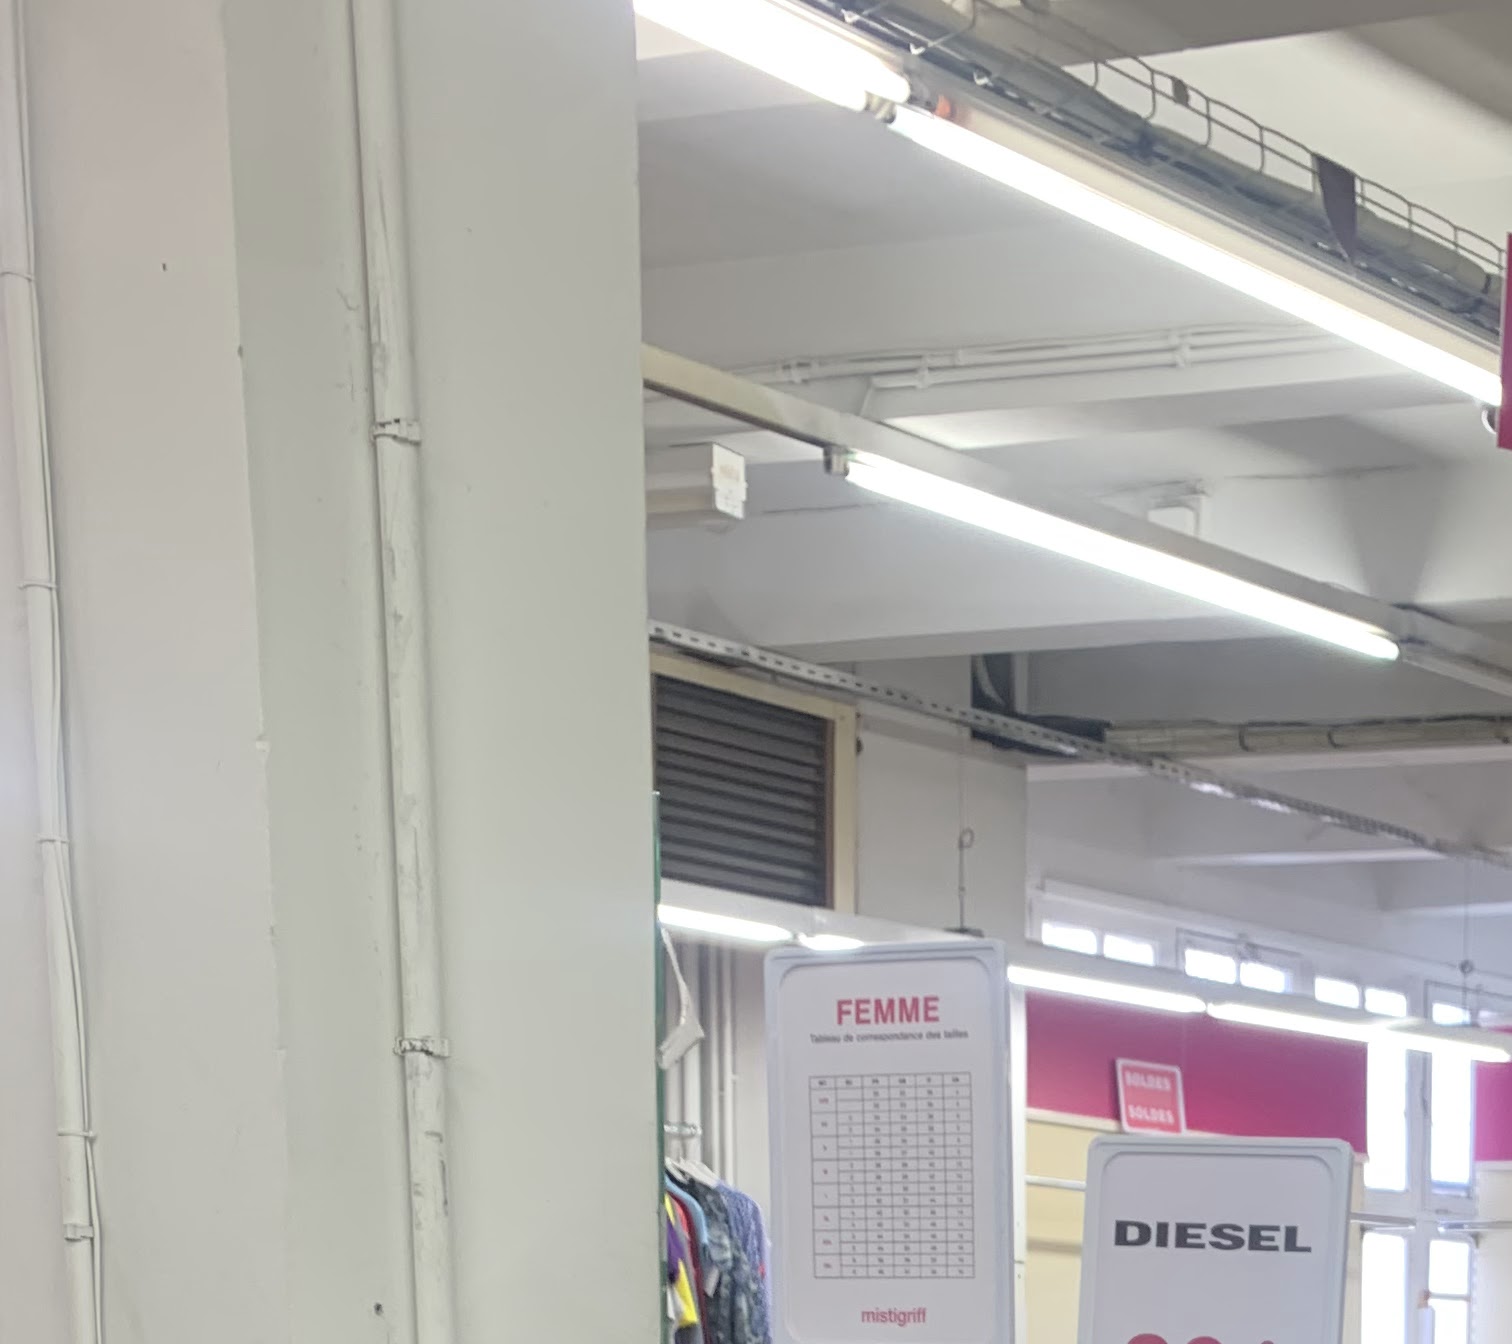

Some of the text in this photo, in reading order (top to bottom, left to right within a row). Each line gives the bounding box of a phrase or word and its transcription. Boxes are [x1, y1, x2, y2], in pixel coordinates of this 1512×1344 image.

[837, 995, 940, 1025] FEMME
[810, 1028, 969, 1043] Tableau de correspondance des tailles
[1113, 1219, 1312, 1253] DIESEL
[861, 1307, 927, 1327] mistigriff
